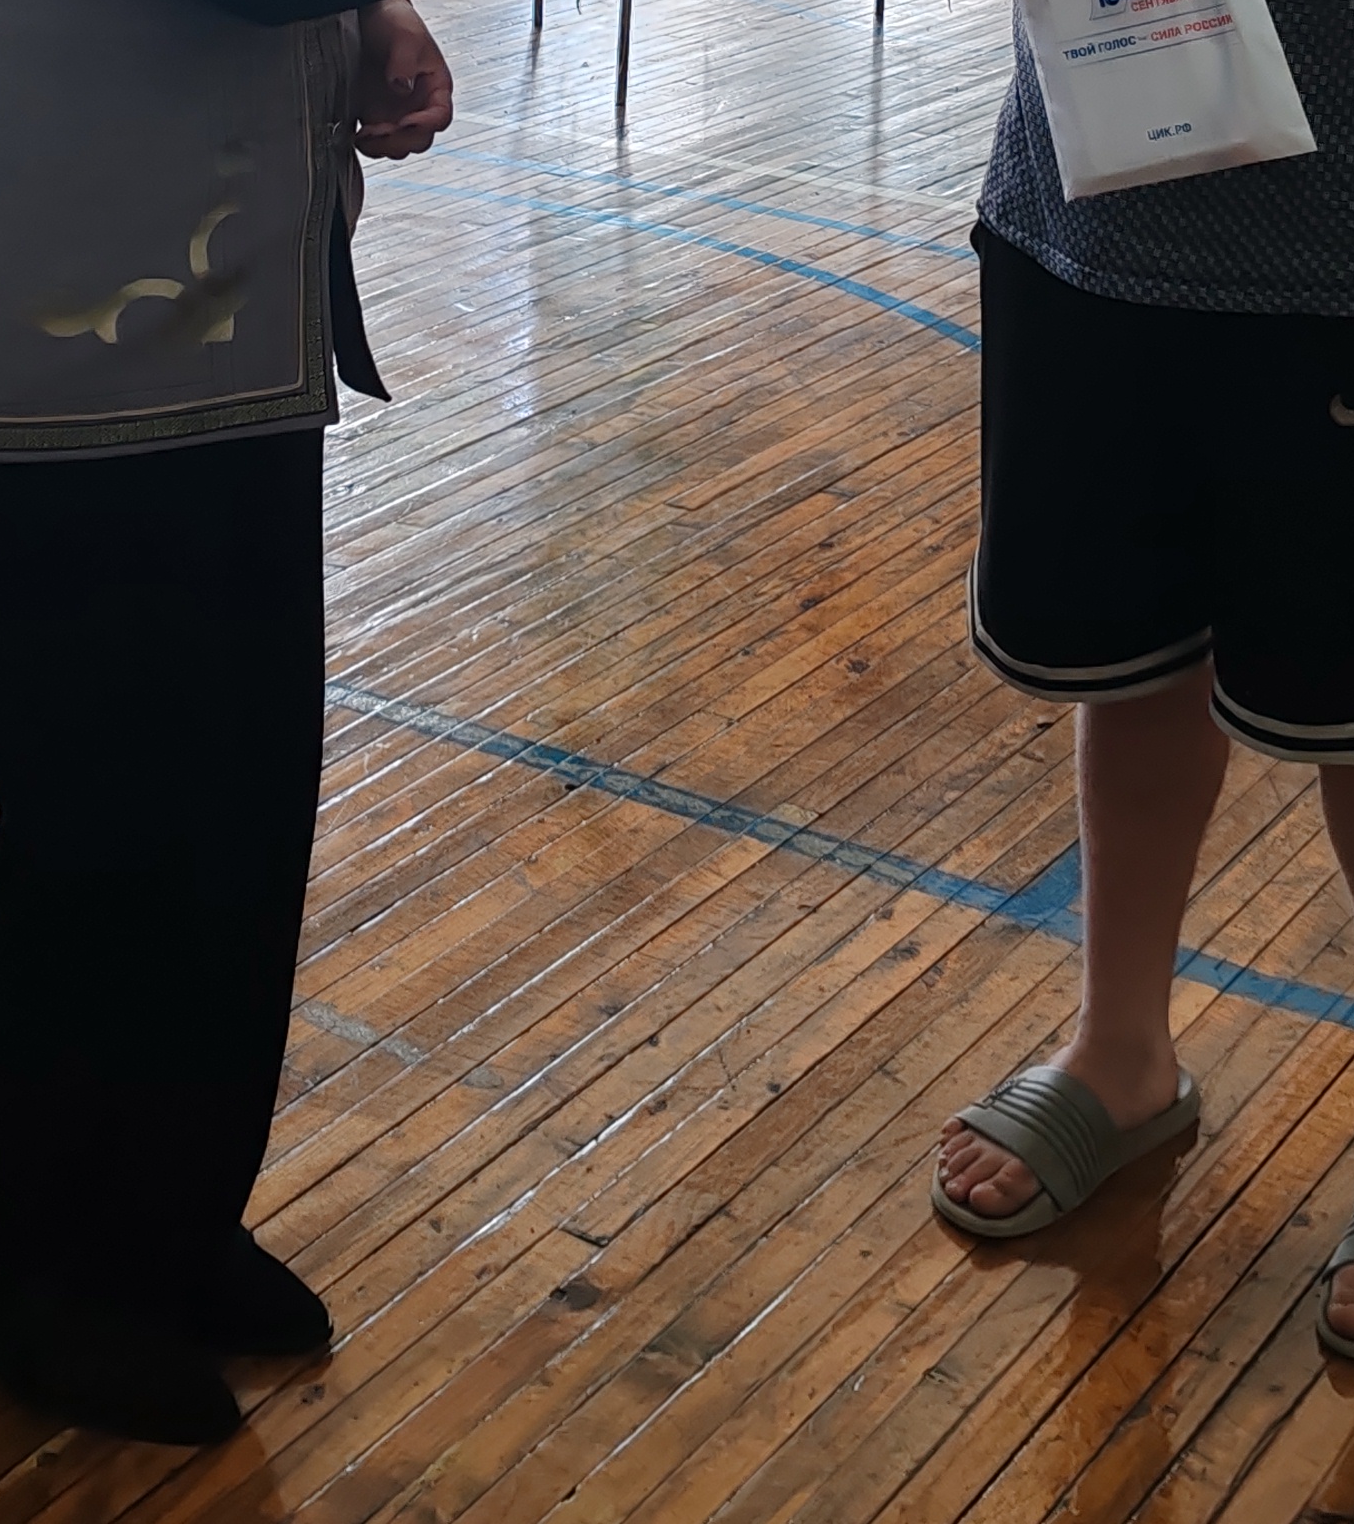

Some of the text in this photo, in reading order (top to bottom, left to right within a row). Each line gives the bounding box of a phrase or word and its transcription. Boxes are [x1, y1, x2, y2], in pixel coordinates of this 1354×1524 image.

[1062, 14, 1233, 60] ТВОЙ ГОЛОС СИЛА РОССИИ
[1147, 122, 1192, 141] ЦИК.РФ
